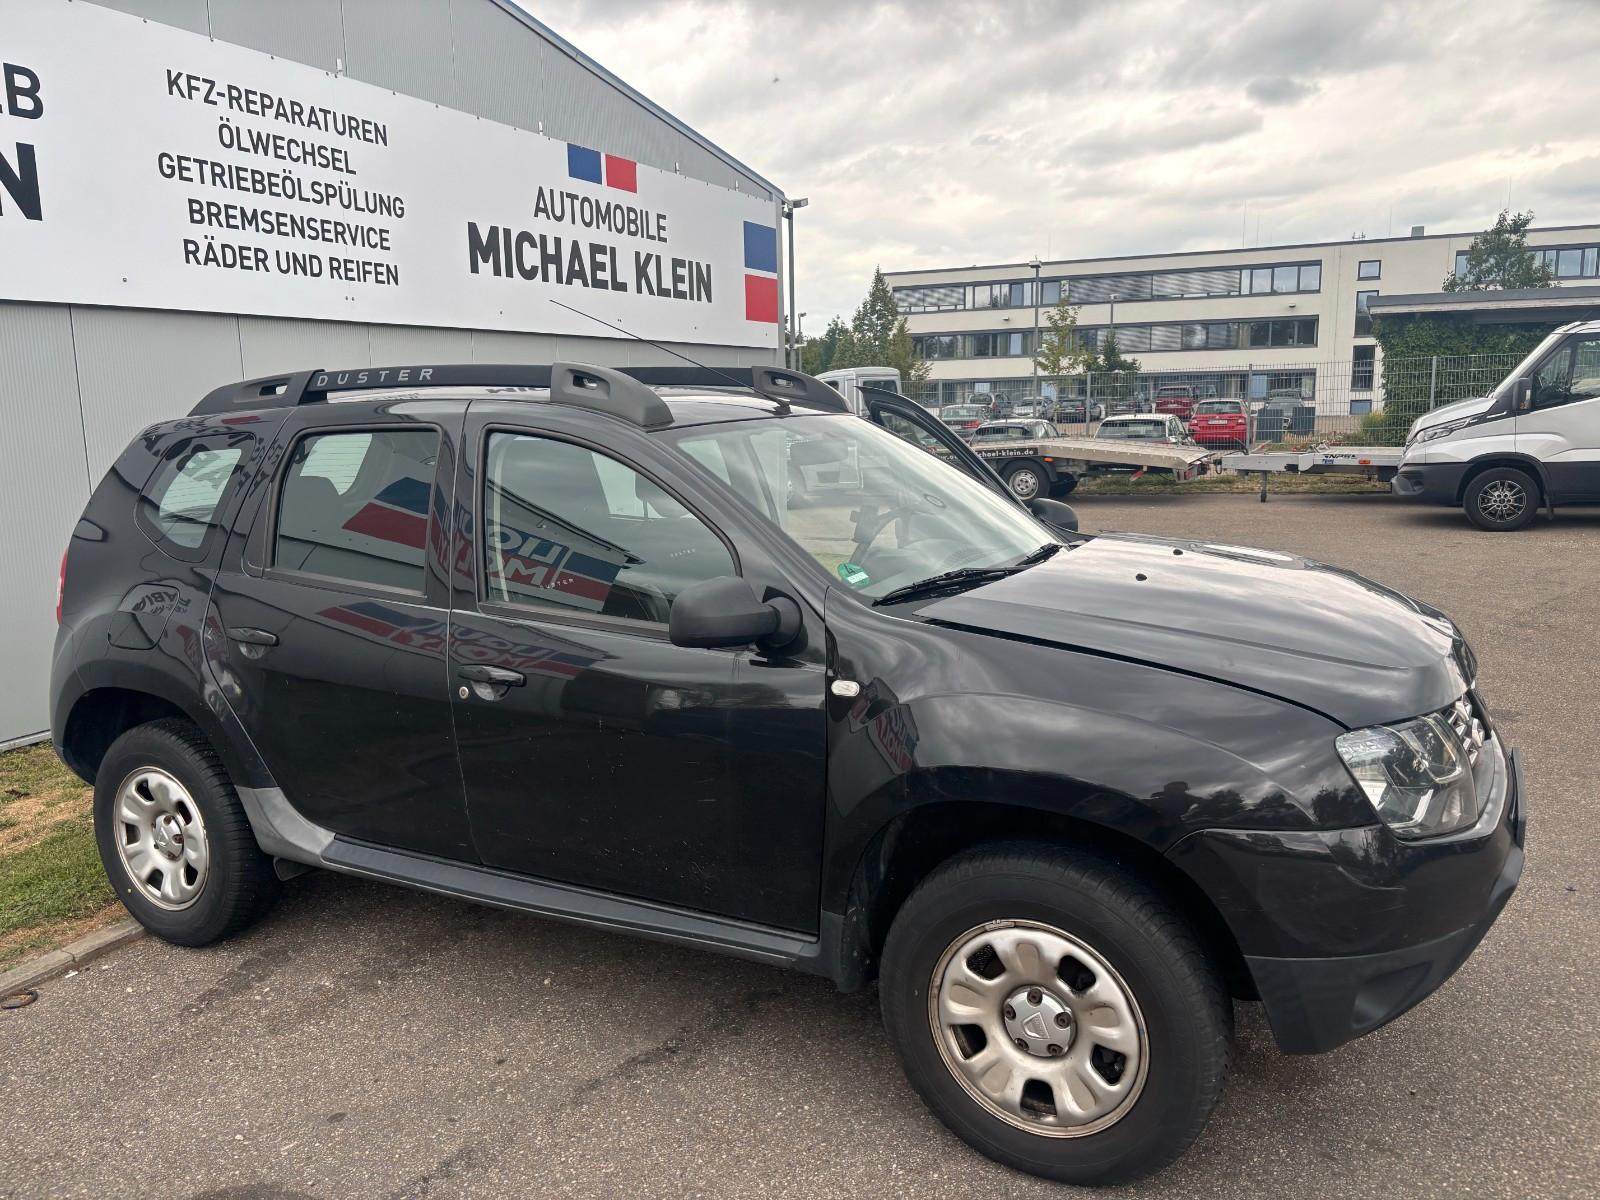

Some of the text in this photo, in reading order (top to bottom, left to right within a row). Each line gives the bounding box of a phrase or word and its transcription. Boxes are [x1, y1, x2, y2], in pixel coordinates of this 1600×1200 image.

[0, 63, 43, 119] B
[167, 69, 387, 146] KFZ-REPARATUREN
[219, 117, 356, 175] ÖLWECHSEL
[158, 153, 404, 218] GETRIEBEÖLSPÜLUNG
[188, 198, 390, 250] BREMSENSERVICE
[534, 186, 667, 243] AUTOMOBILE
[183, 236, 398, 285] RÄDER UND REIFEN
[468, 222, 712, 303] MICHAEL KLEIN
[316, 368, 433, 387] DUSTER
